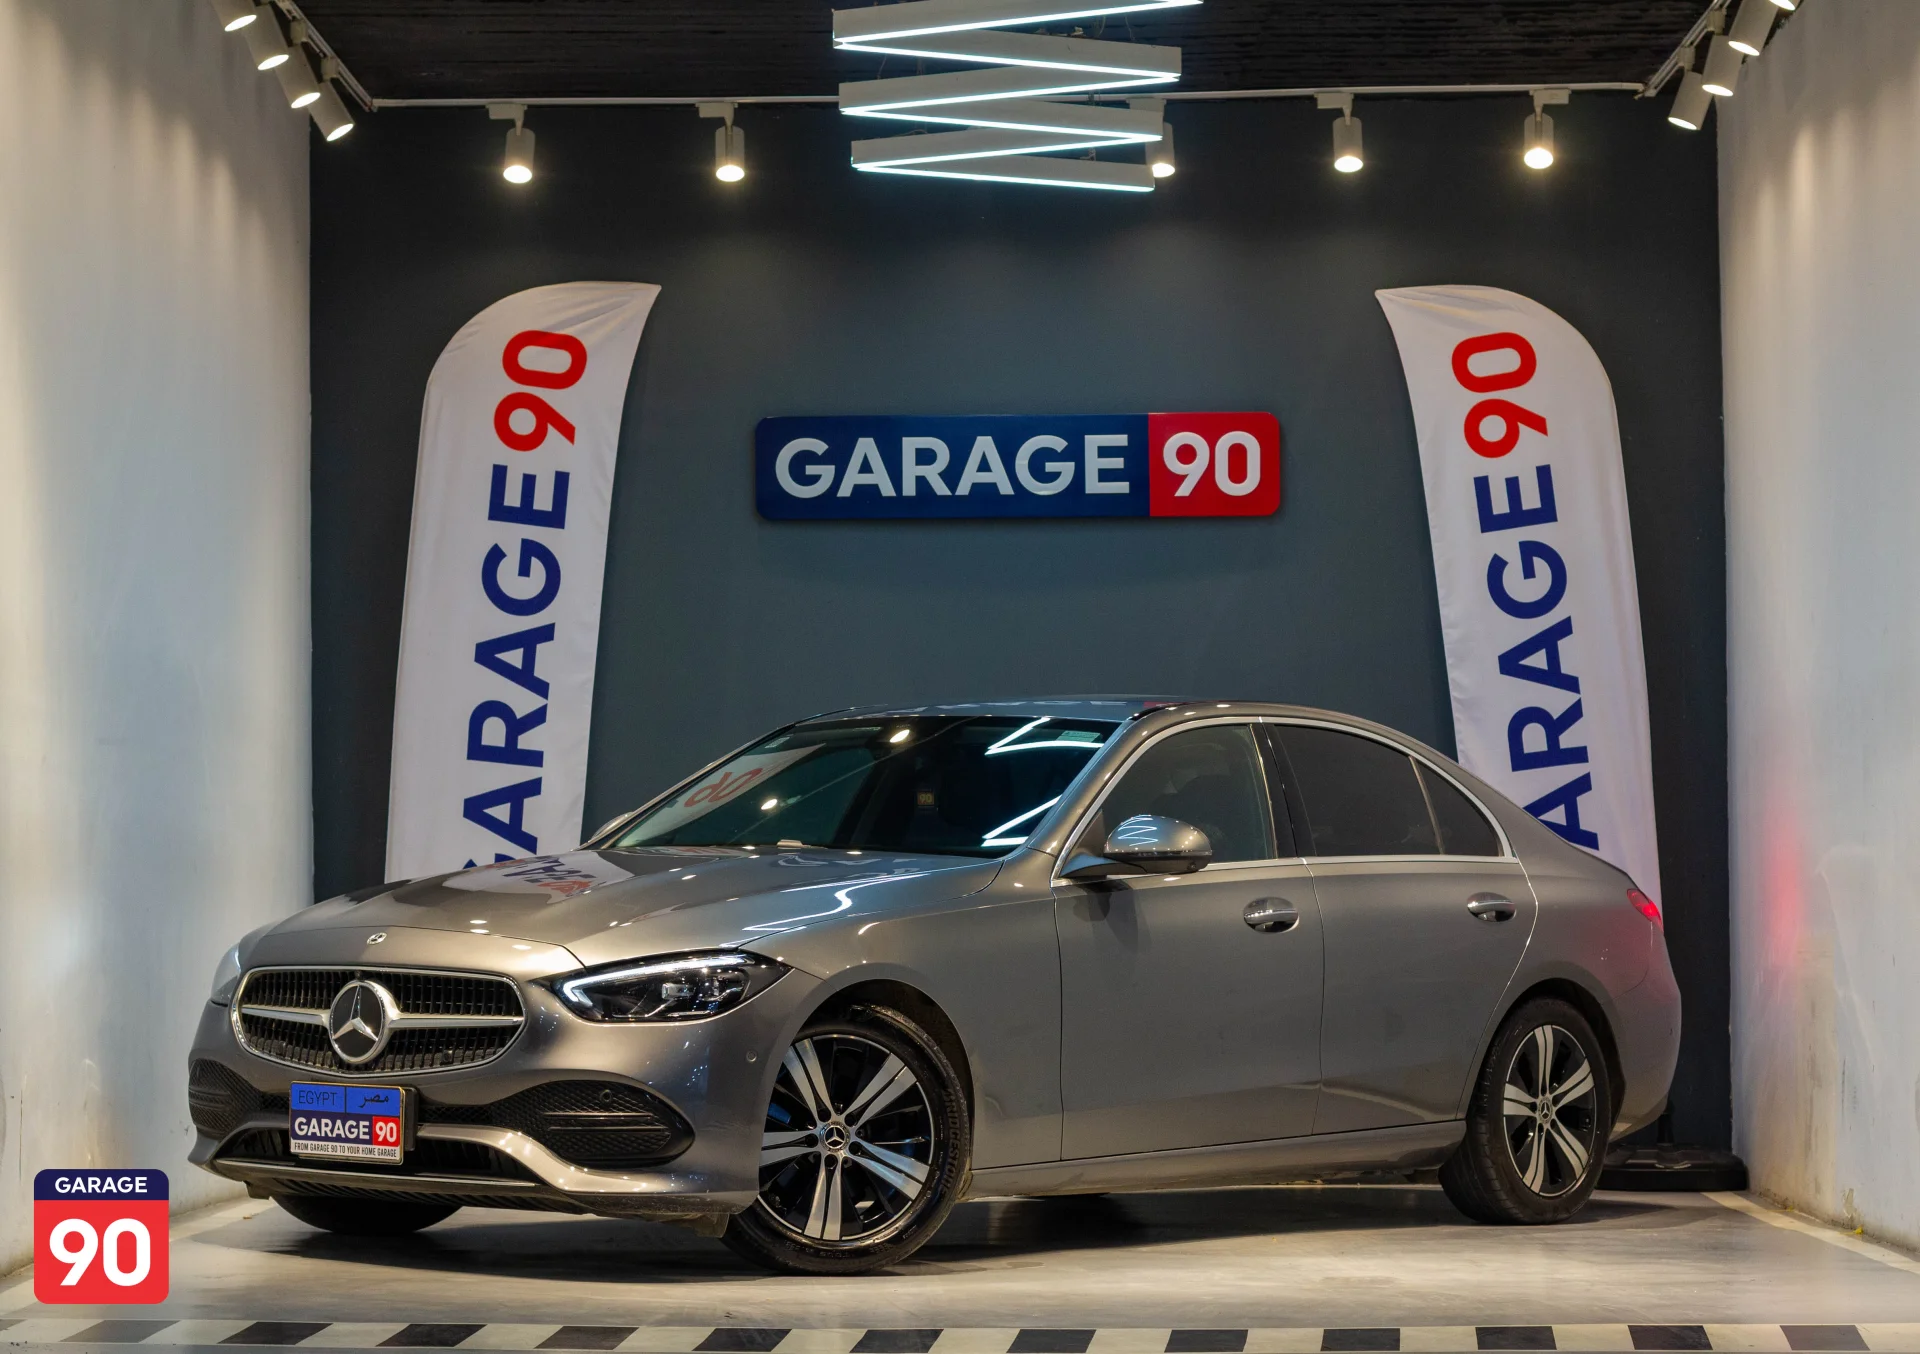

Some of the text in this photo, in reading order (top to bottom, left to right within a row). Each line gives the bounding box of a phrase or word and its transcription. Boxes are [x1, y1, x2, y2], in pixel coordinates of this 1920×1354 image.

[775, 430, 1261, 498] GARAGE 90
[298, 1090, 338, 1106] EGYPT
[358, 1094, 389, 1108] مصر
[294, 1116, 397, 1143] GARAGE 90
[294, 1142, 397, 1158] FROM GARAGE 90 TO YOUR HOME GARAGE
